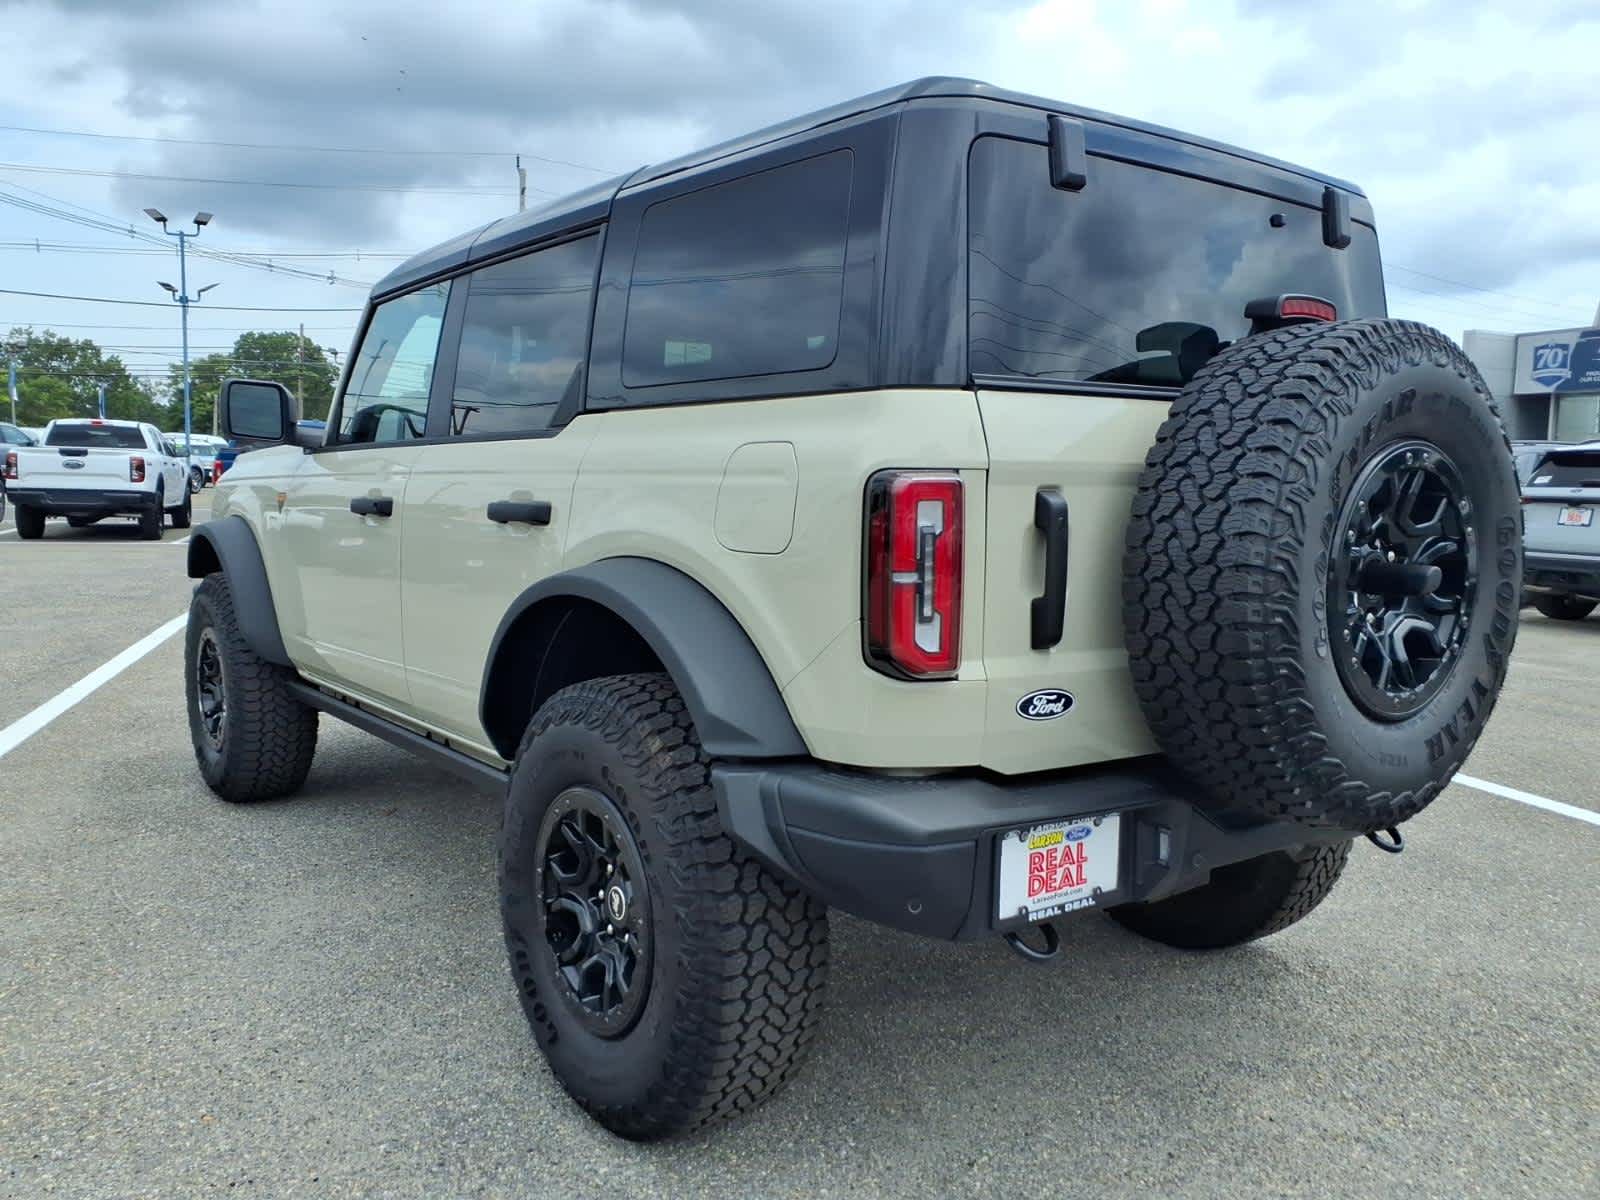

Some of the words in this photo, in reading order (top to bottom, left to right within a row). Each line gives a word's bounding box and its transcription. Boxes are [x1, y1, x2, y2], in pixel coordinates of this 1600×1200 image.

[1536, 348, 1563, 369] 70
[1028, 694, 1065, 715] Ford
[1028, 830, 1064, 849] LARSON
[1029, 843, 1088, 875] REAL
[1028, 863, 1087, 897] DEAL
[1028, 907, 1062, 922] REAL
[1064, 897, 1096, 913] DEAL
